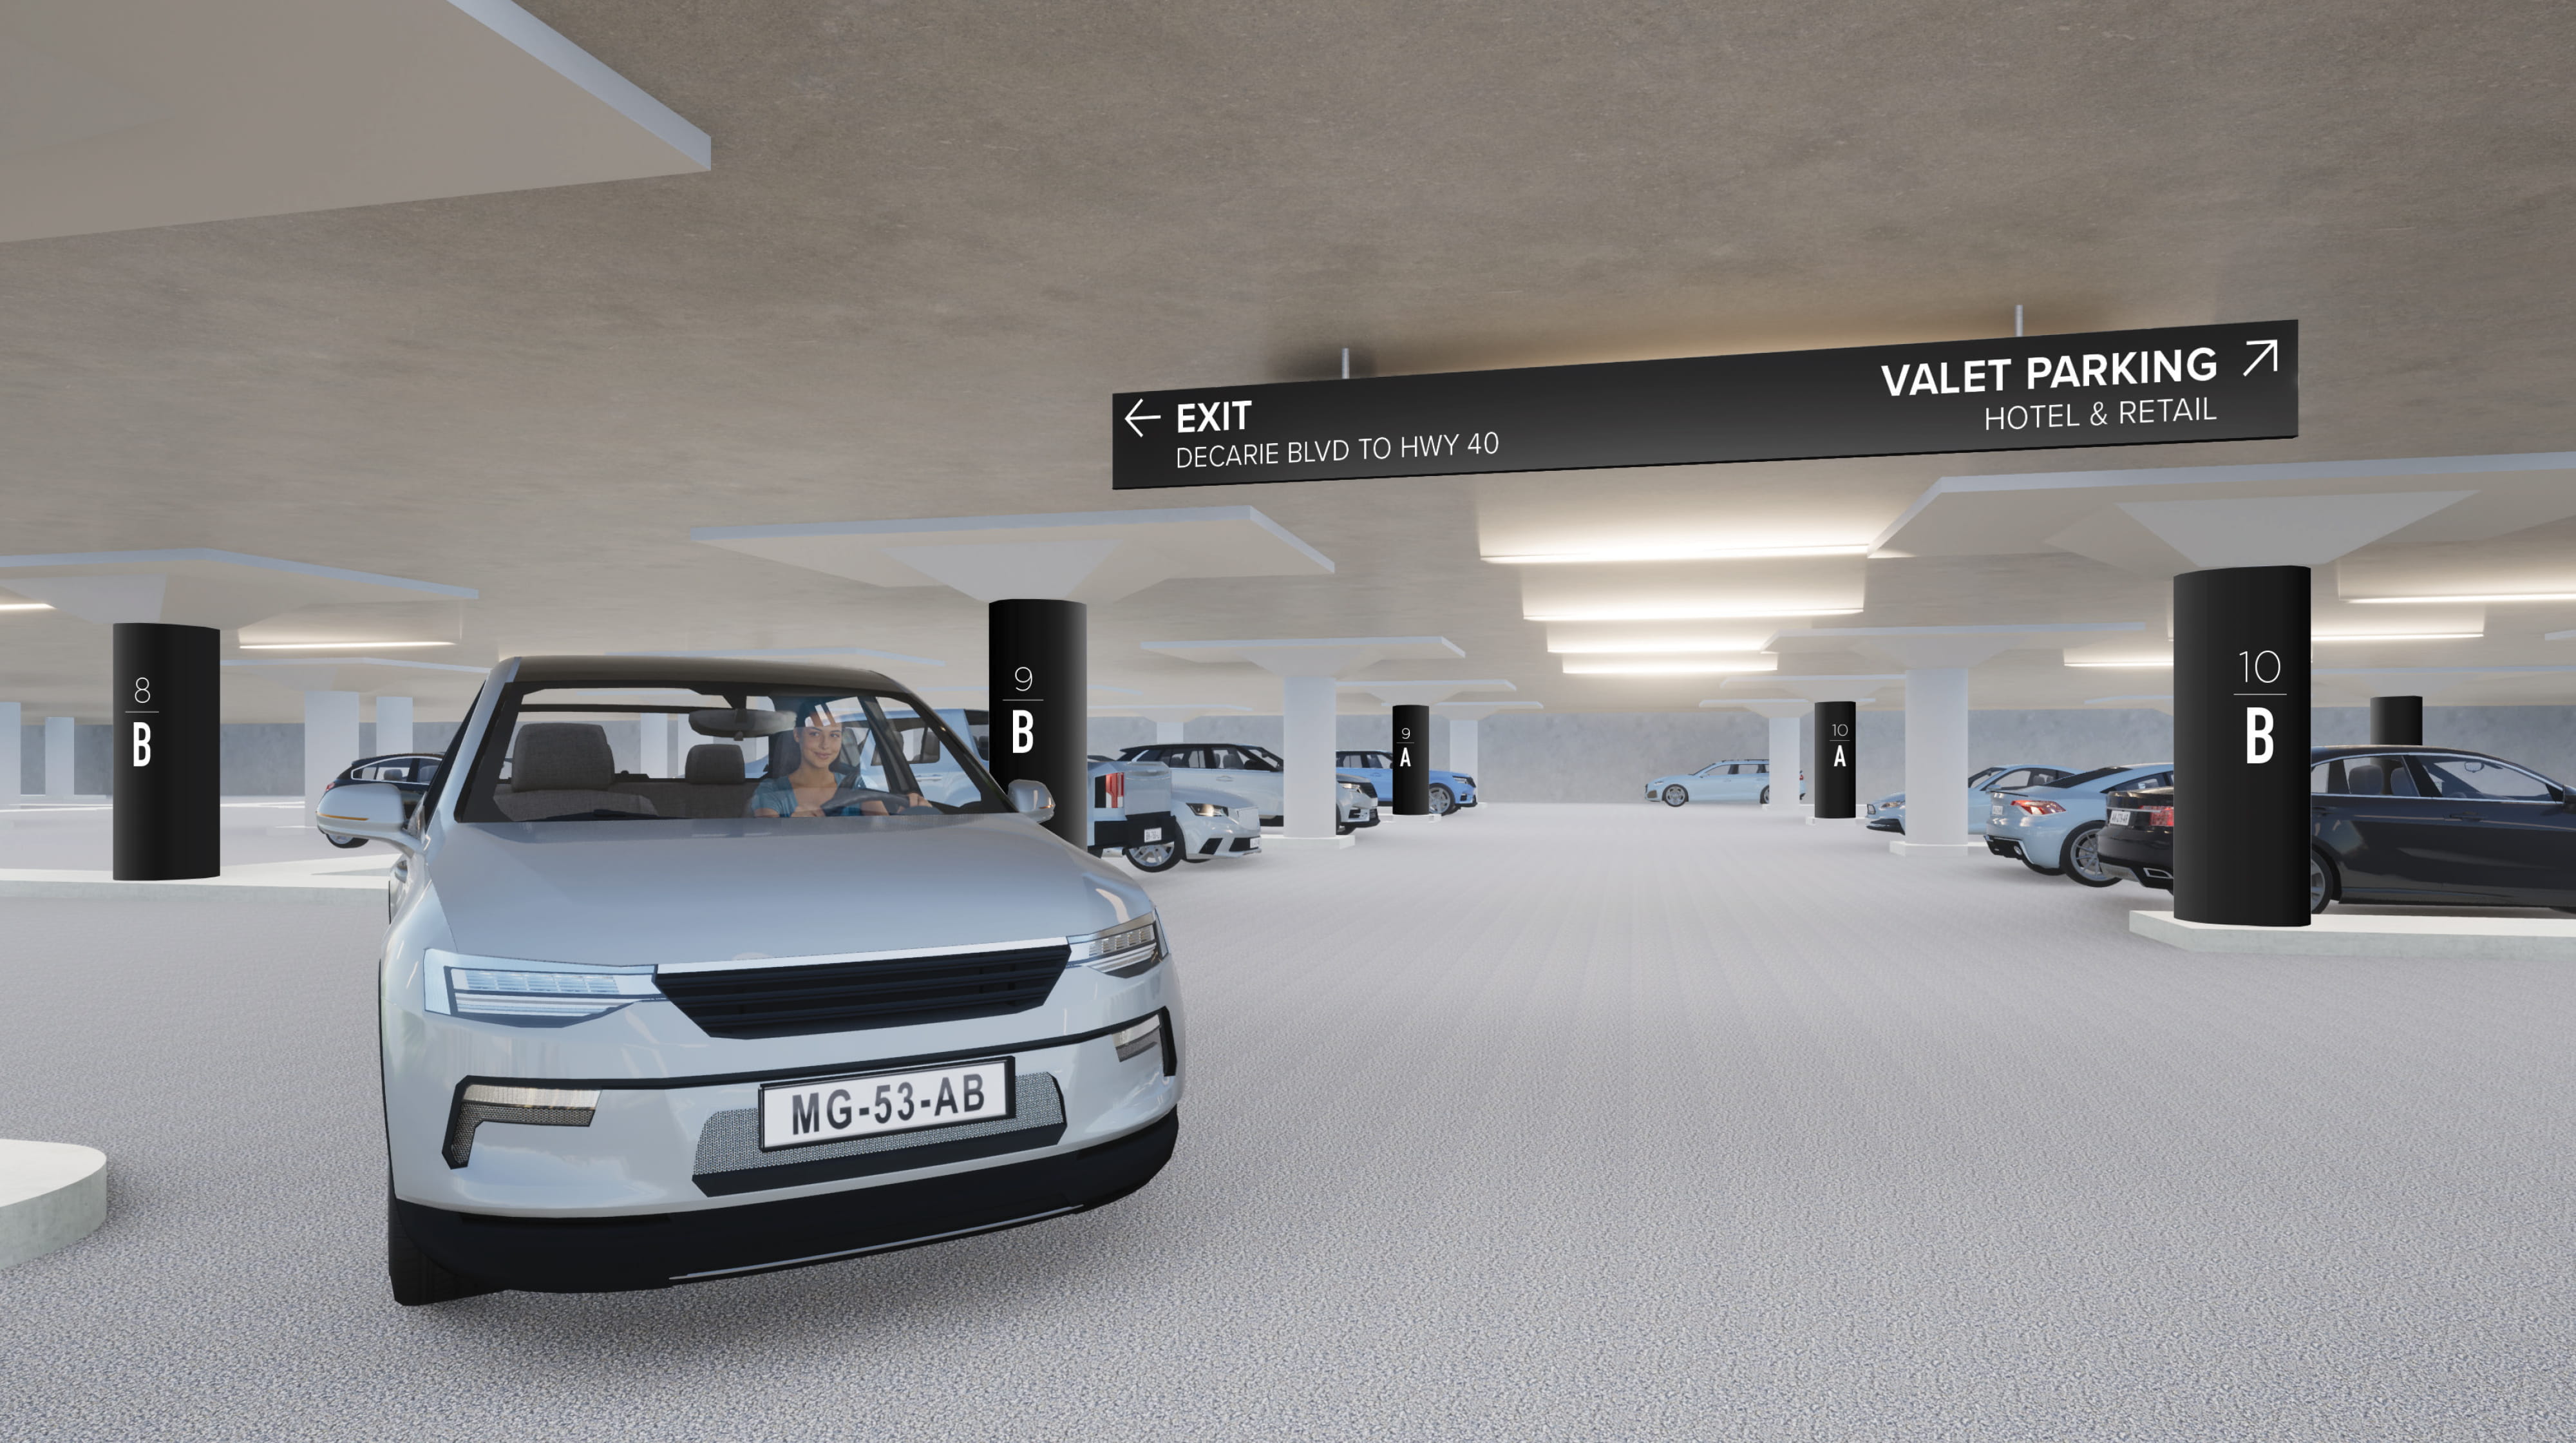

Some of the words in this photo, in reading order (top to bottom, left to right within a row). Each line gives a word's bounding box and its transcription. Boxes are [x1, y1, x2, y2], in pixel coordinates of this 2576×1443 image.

[1880, 358, 2012, 397] VALET
[2027, 347, 2217, 390] PARKING
[1177, 400, 1253, 434] EXIT
[1985, 403, 2080, 431] HOTEL
[2090, 401, 2108, 426] &
[2119, 396, 2217, 425] RETAIL
[1177, 443, 1278, 468] DECARIE
[1288, 439, 1349, 463] BLVD
[1358, 436, 1391, 461] TO
[1401, 434, 1460, 459] HWY
[1467, 432, 1499, 455] 40
[1014, 666, 1033, 692] 9
[2239, 650, 2281, 683] 10
[135, 677, 151, 703] 8
[133, 722, 151, 767] B
[1012, 709, 1034, 754] B
[1401, 727, 1410, 740] 9
[1832, 724, 1848, 736] 10
[2246, 707, 2274, 764] B
[1399, 747, 1411, 767] A
[1833, 745, 1846, 767] A
[791, 1073, 985, 1136] MG-53-AB
